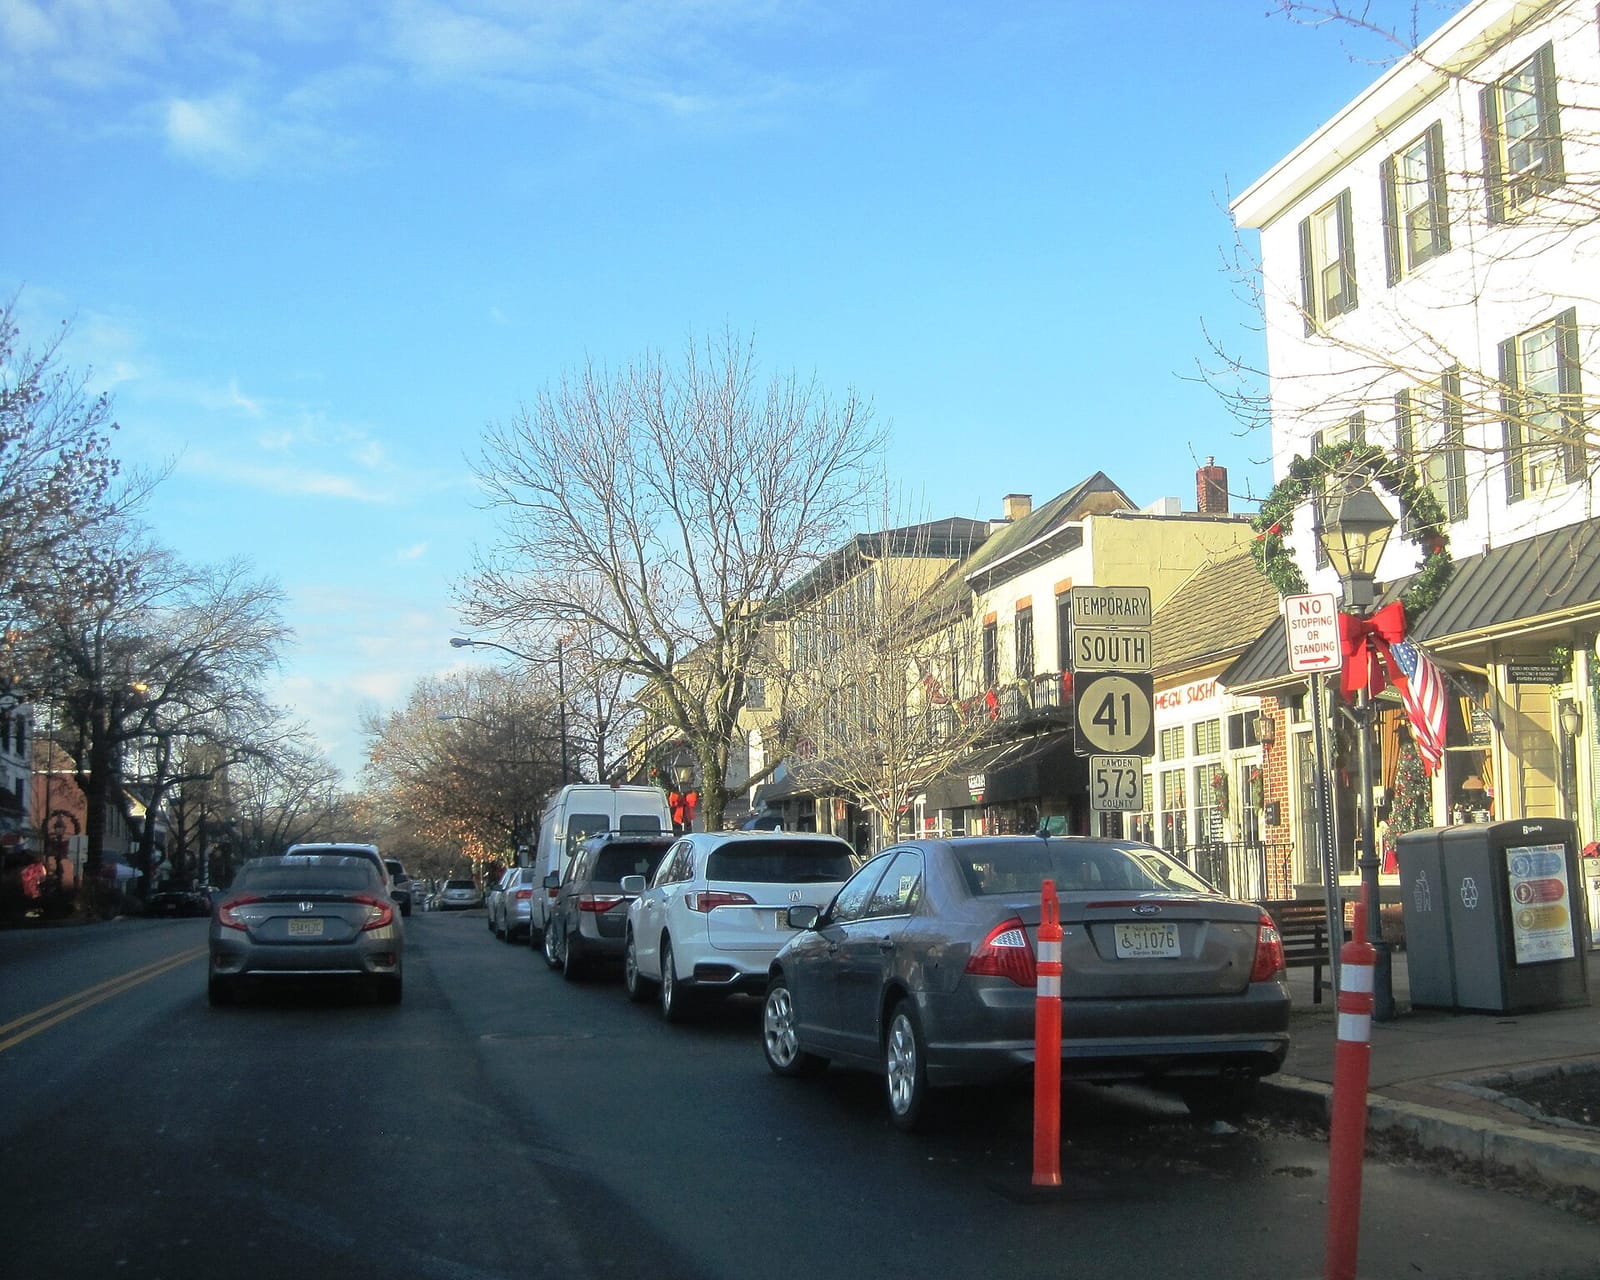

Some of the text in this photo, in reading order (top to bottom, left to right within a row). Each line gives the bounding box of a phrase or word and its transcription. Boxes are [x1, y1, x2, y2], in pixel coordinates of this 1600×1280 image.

[1075, 597, 1147, 616] TEMPORARY
[1299, 600, 1321, 615] NO
[1291, 616, 1333, 629] STOPPING
[1307, 631, 1319, 640] OR
[1081, 636, 1144, 663] SOUTH
[1294, 641, 1335, 655] STANDING
[1187, 681, 1216, 704] SUSHI
[1092, 692, 1131, 736] 41
[1101, 759, 1133, 767] CAMDEN
[1097, 769, 1137, 799] 573
[1102, 799, 1134, 808] COUNTY
